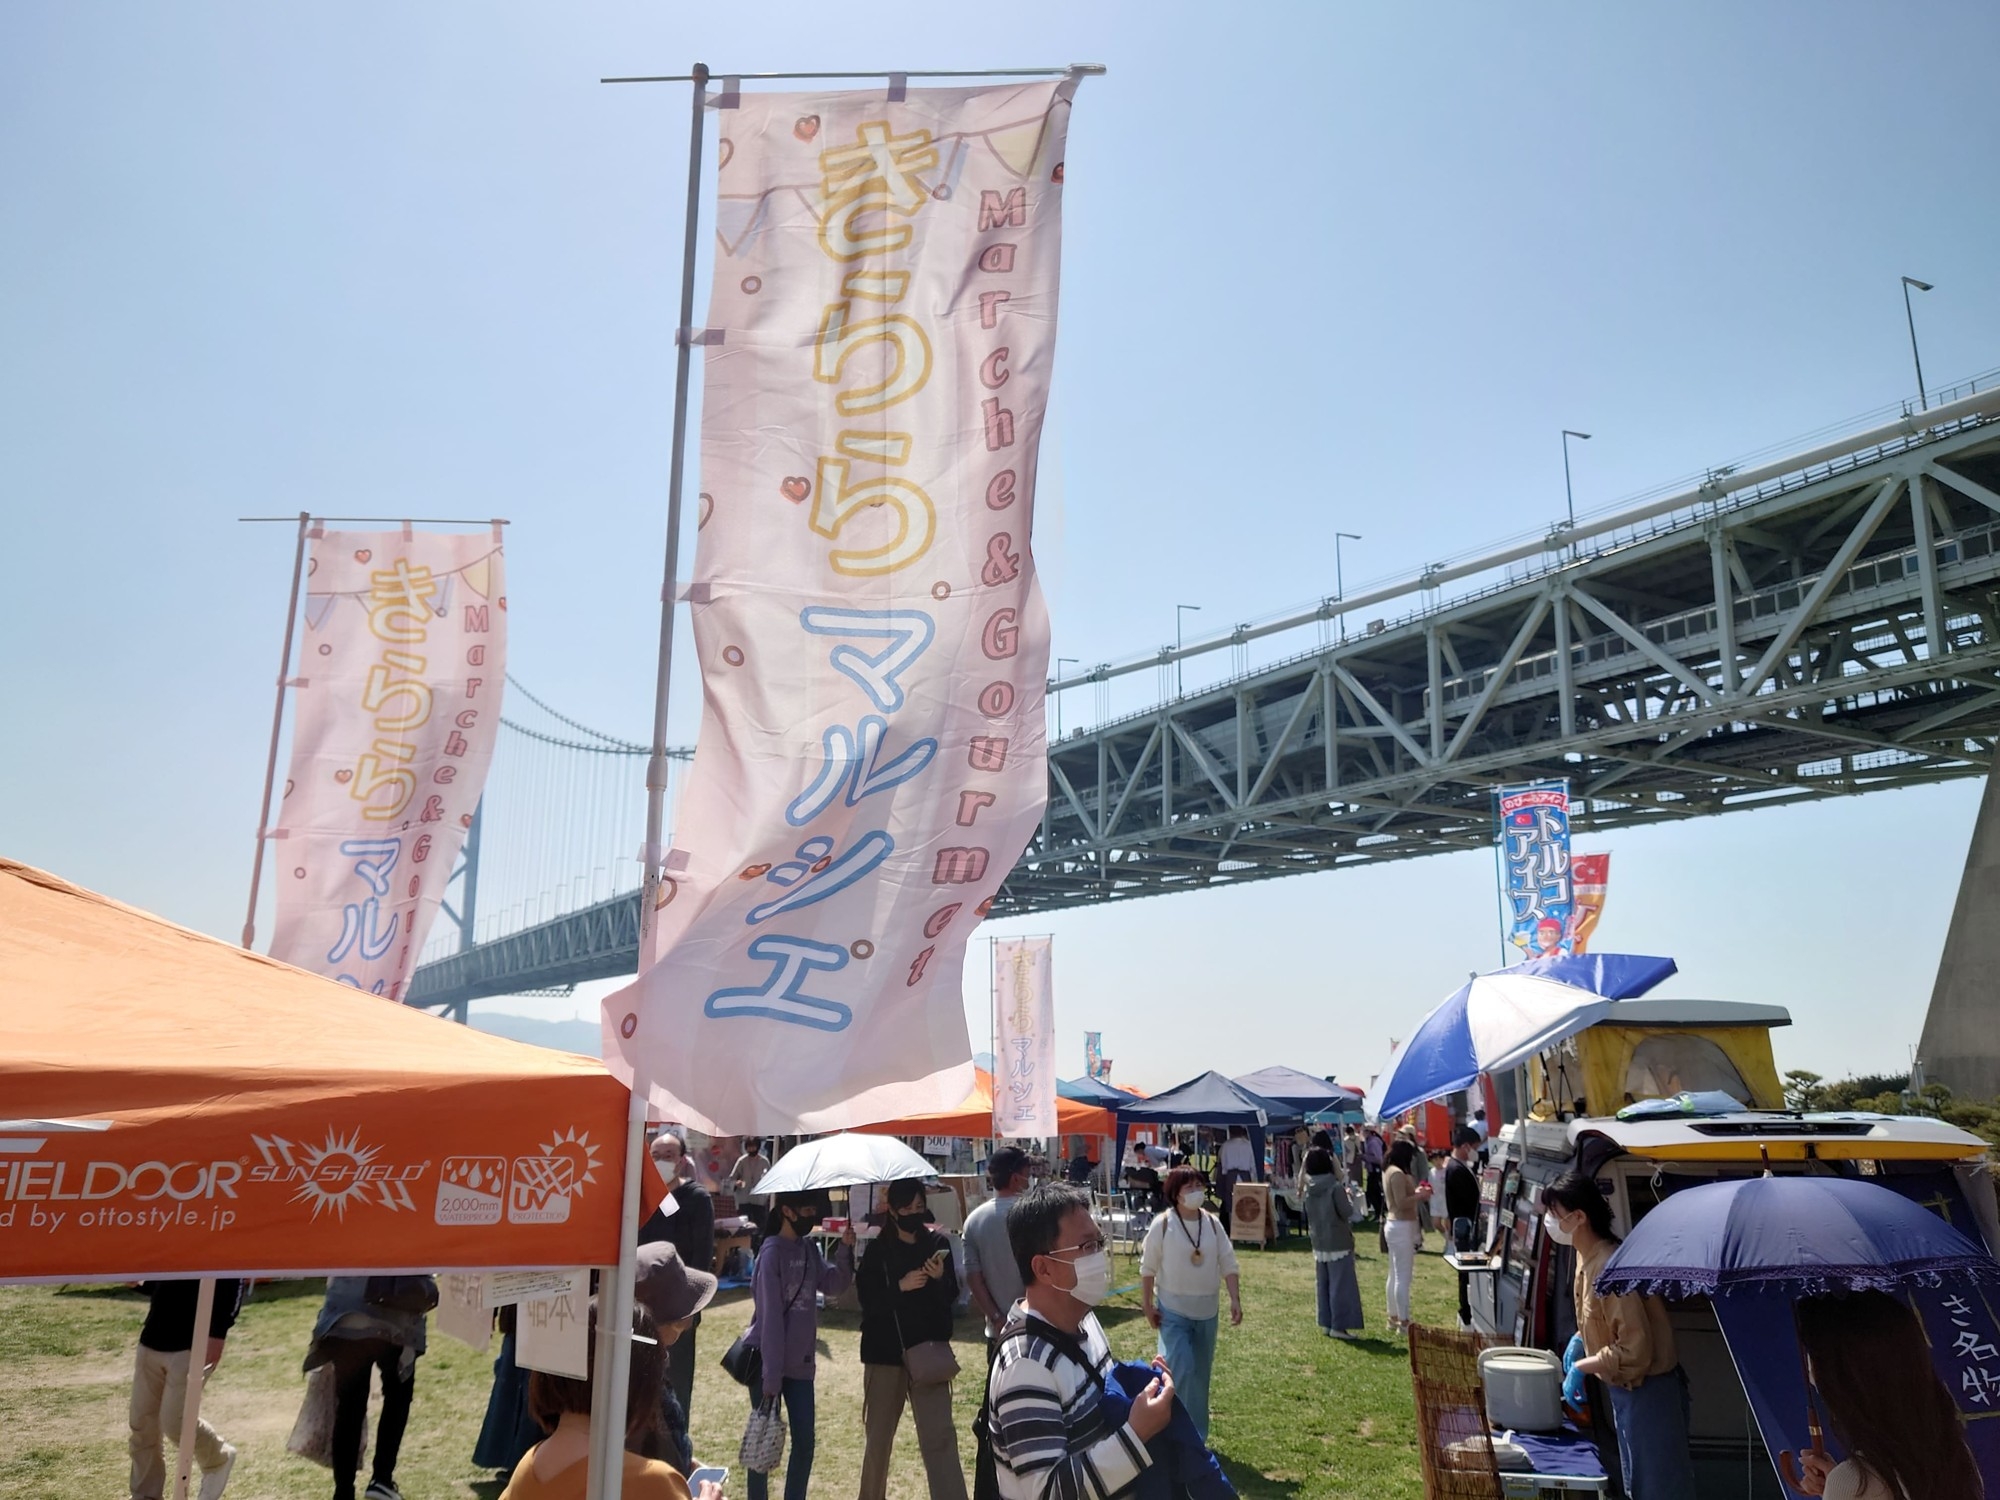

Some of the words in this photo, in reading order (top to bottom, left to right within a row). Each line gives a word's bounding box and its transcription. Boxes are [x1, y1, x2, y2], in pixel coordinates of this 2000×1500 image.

[1507, 826, 1546, 923] アイス
[1537, 808, 1570, 905] トルコ
[30, 1203, 66, 1234] by
[79, 1202, 237, 1233] ottostyle.jp
